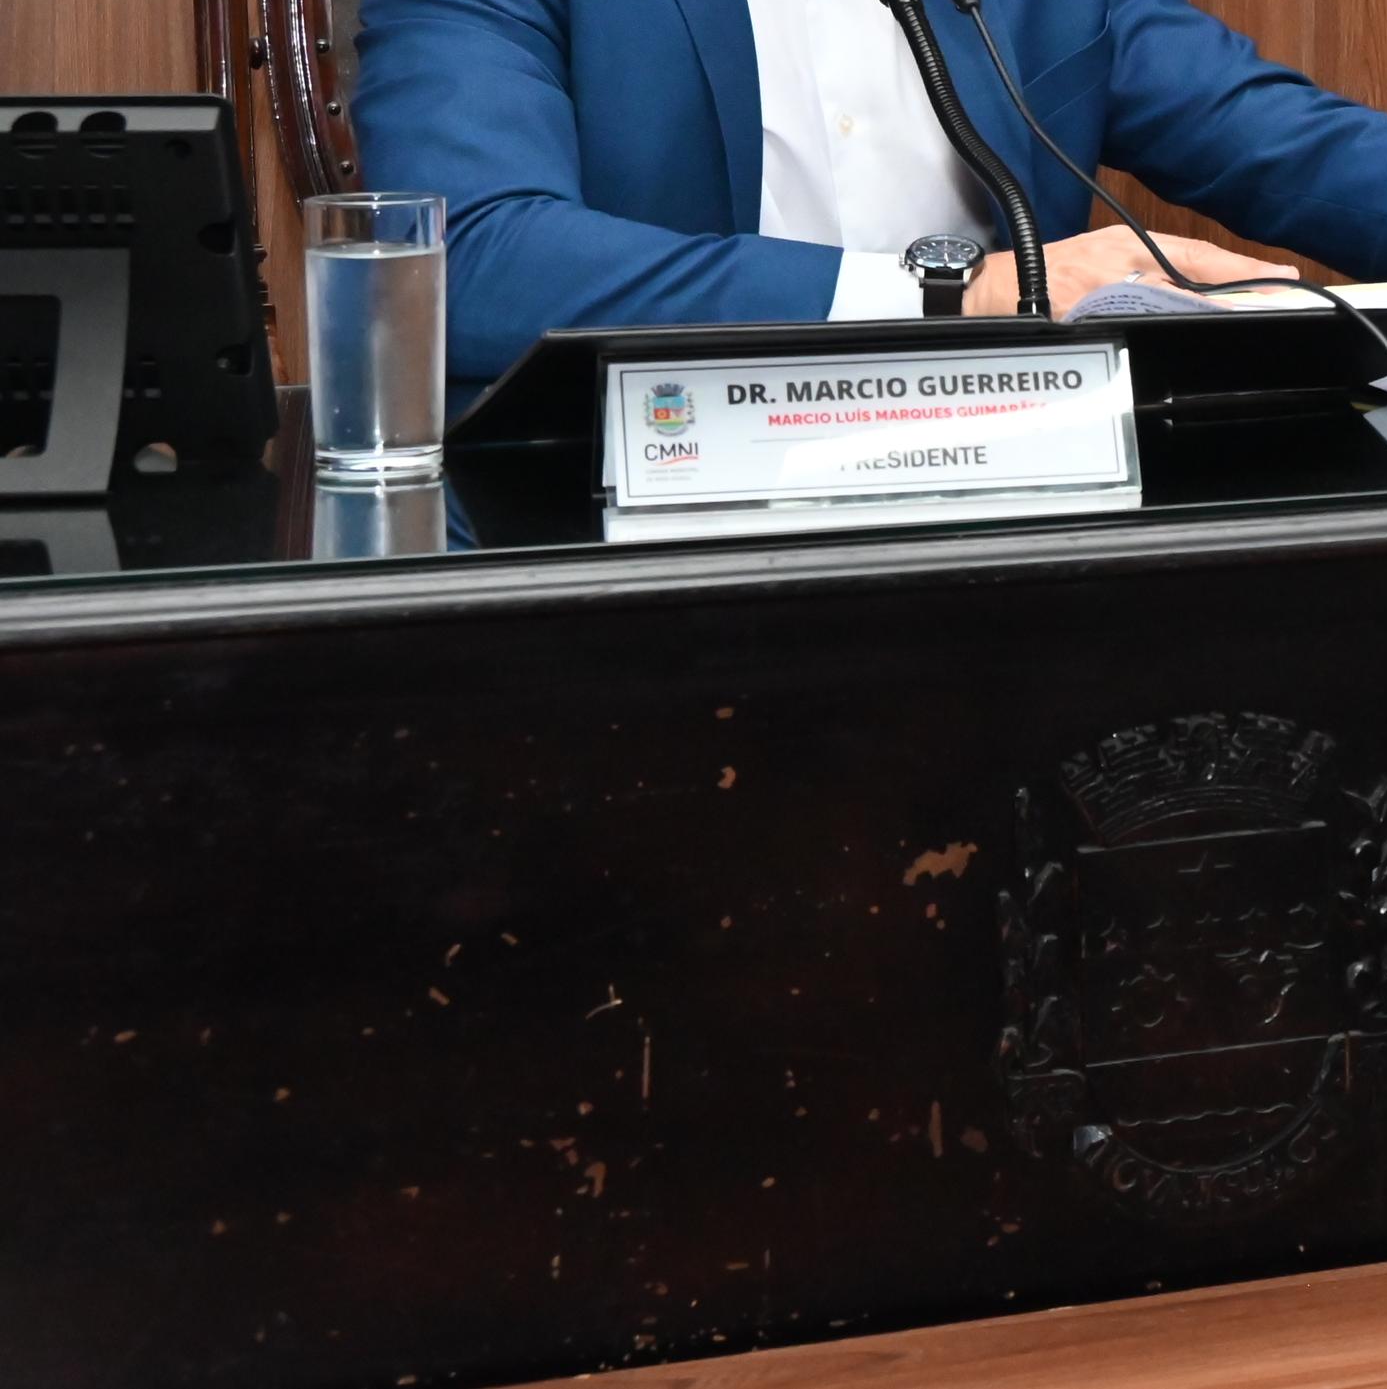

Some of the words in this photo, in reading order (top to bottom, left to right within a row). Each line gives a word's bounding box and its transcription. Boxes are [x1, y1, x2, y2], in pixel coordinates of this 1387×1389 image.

[727, 383, 776, 405] DR.
[786, 377, 907, 403] MARCIO
[918, 370, 1083, 396] GUERREIRO
[768, 412, 831, 426] MARCIO
[836, 408, 871, 424] LUÍS
[876, 407, 952, 422] MARQUES
[644, 442, 699, 461] CMNI
